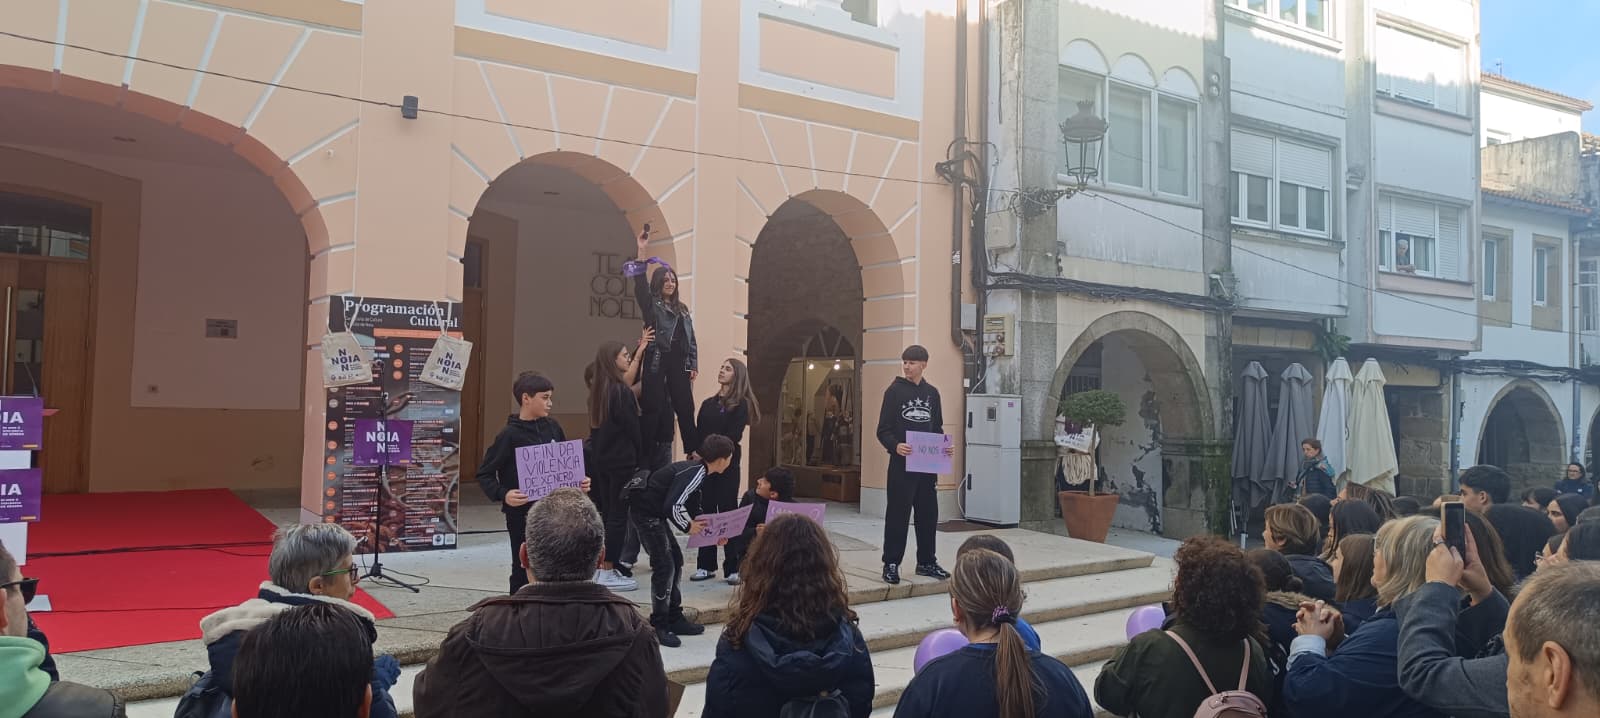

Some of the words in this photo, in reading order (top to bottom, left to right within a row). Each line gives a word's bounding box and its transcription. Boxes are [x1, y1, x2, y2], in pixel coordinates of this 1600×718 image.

[345, 300, 444, 316] Programación
[410, 315, 458, 328] Cultural
[331, 354, 361, 365] NOIA
[437, 357, 461, 370] NOIA
[0, 411, 24, 424] IA
[366, 431, 399, 442] NOIA
[522, 447, 530, 462] O
[533, 445, 554, 460] FIN
[559, 442, 574, 457] DA
[525, 455, 580, 476] VIOLENCIA
[524, 477, 538, 489] DE
